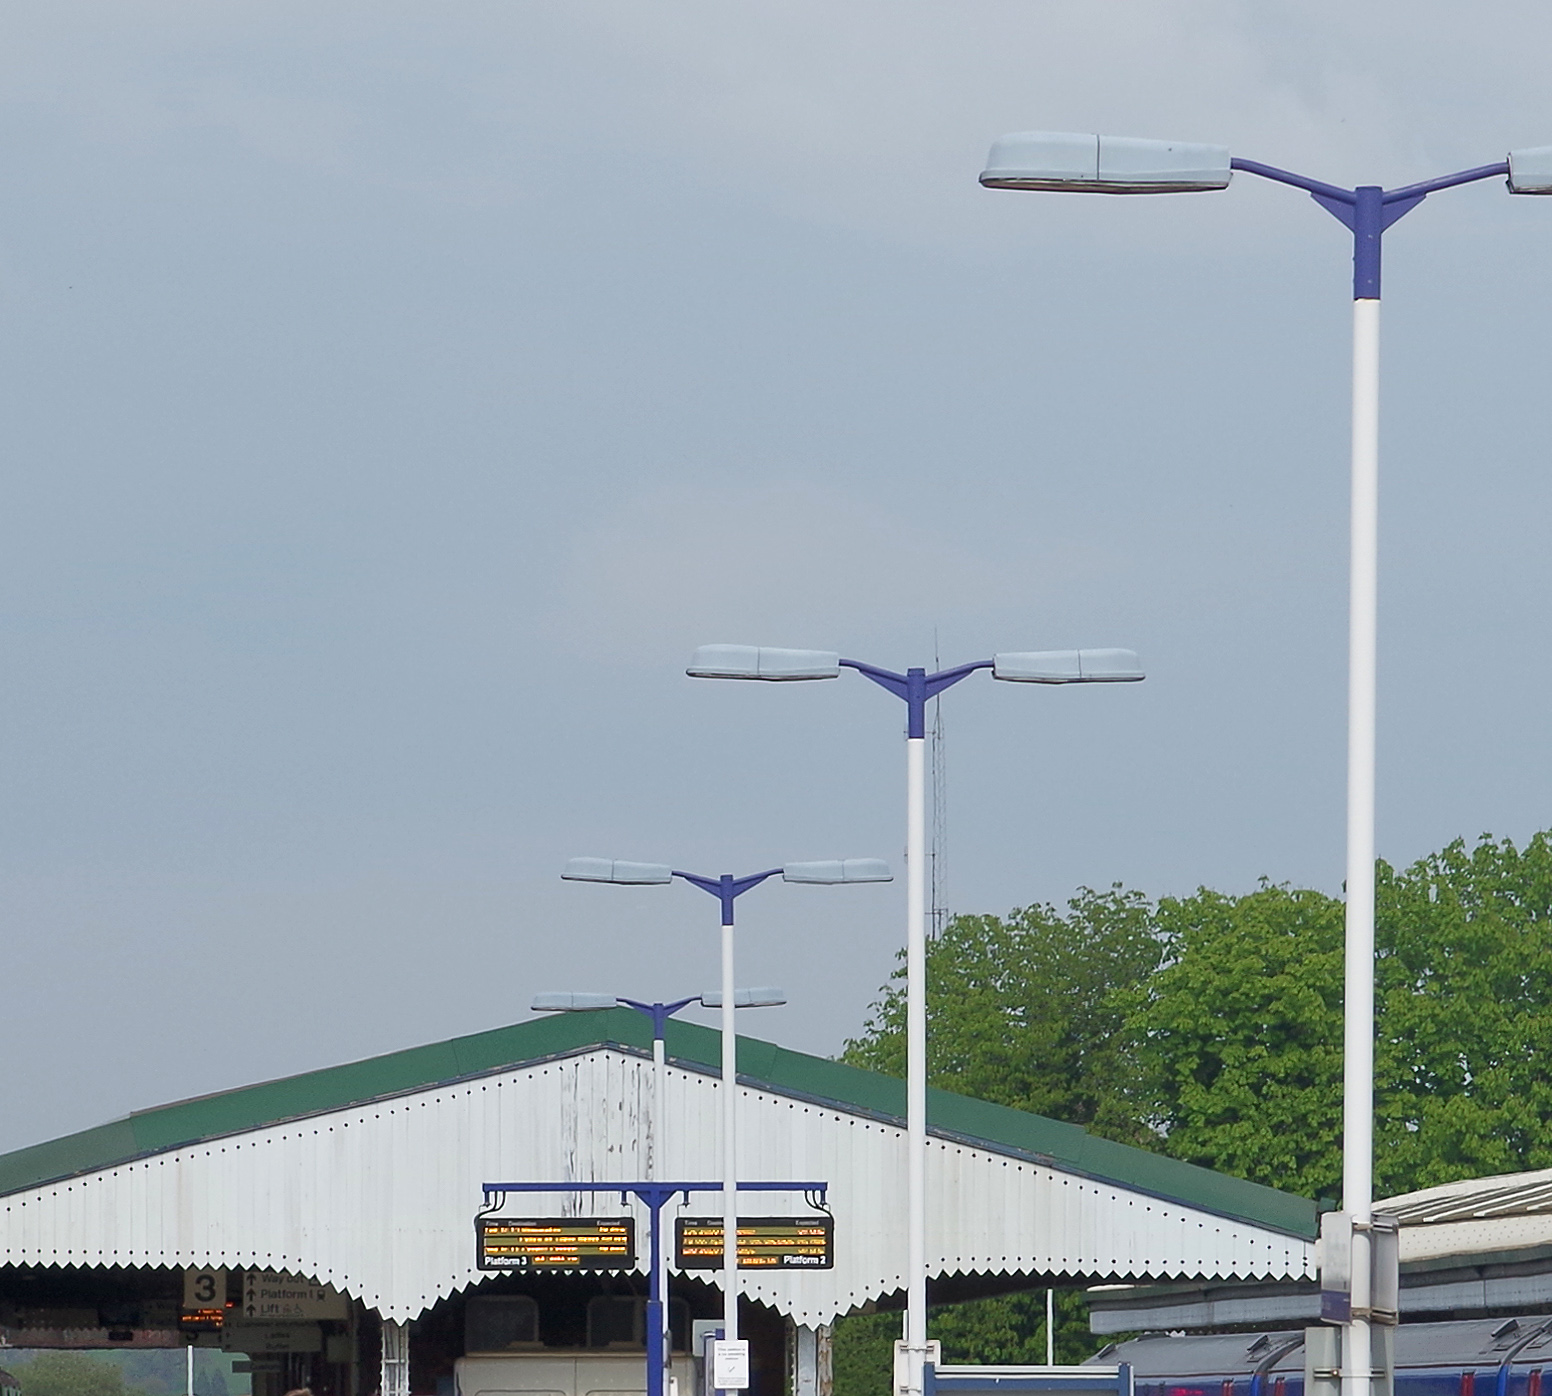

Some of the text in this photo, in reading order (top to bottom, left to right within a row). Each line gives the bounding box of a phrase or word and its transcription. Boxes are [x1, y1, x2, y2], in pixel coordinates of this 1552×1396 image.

[484, 1257, 520, 1266] Platform
[521, 1257, 528, 1265] 3
[783, 1256, 819, 1265] Platform
[820, 1256, 826, 1264] 2
[261, 1274, 284, 1285] Way
[195, 1274, 216, 1302] 3
[261, 1288, 307, 1299] Platform
[261, 1304, 279, 1313] Lift
